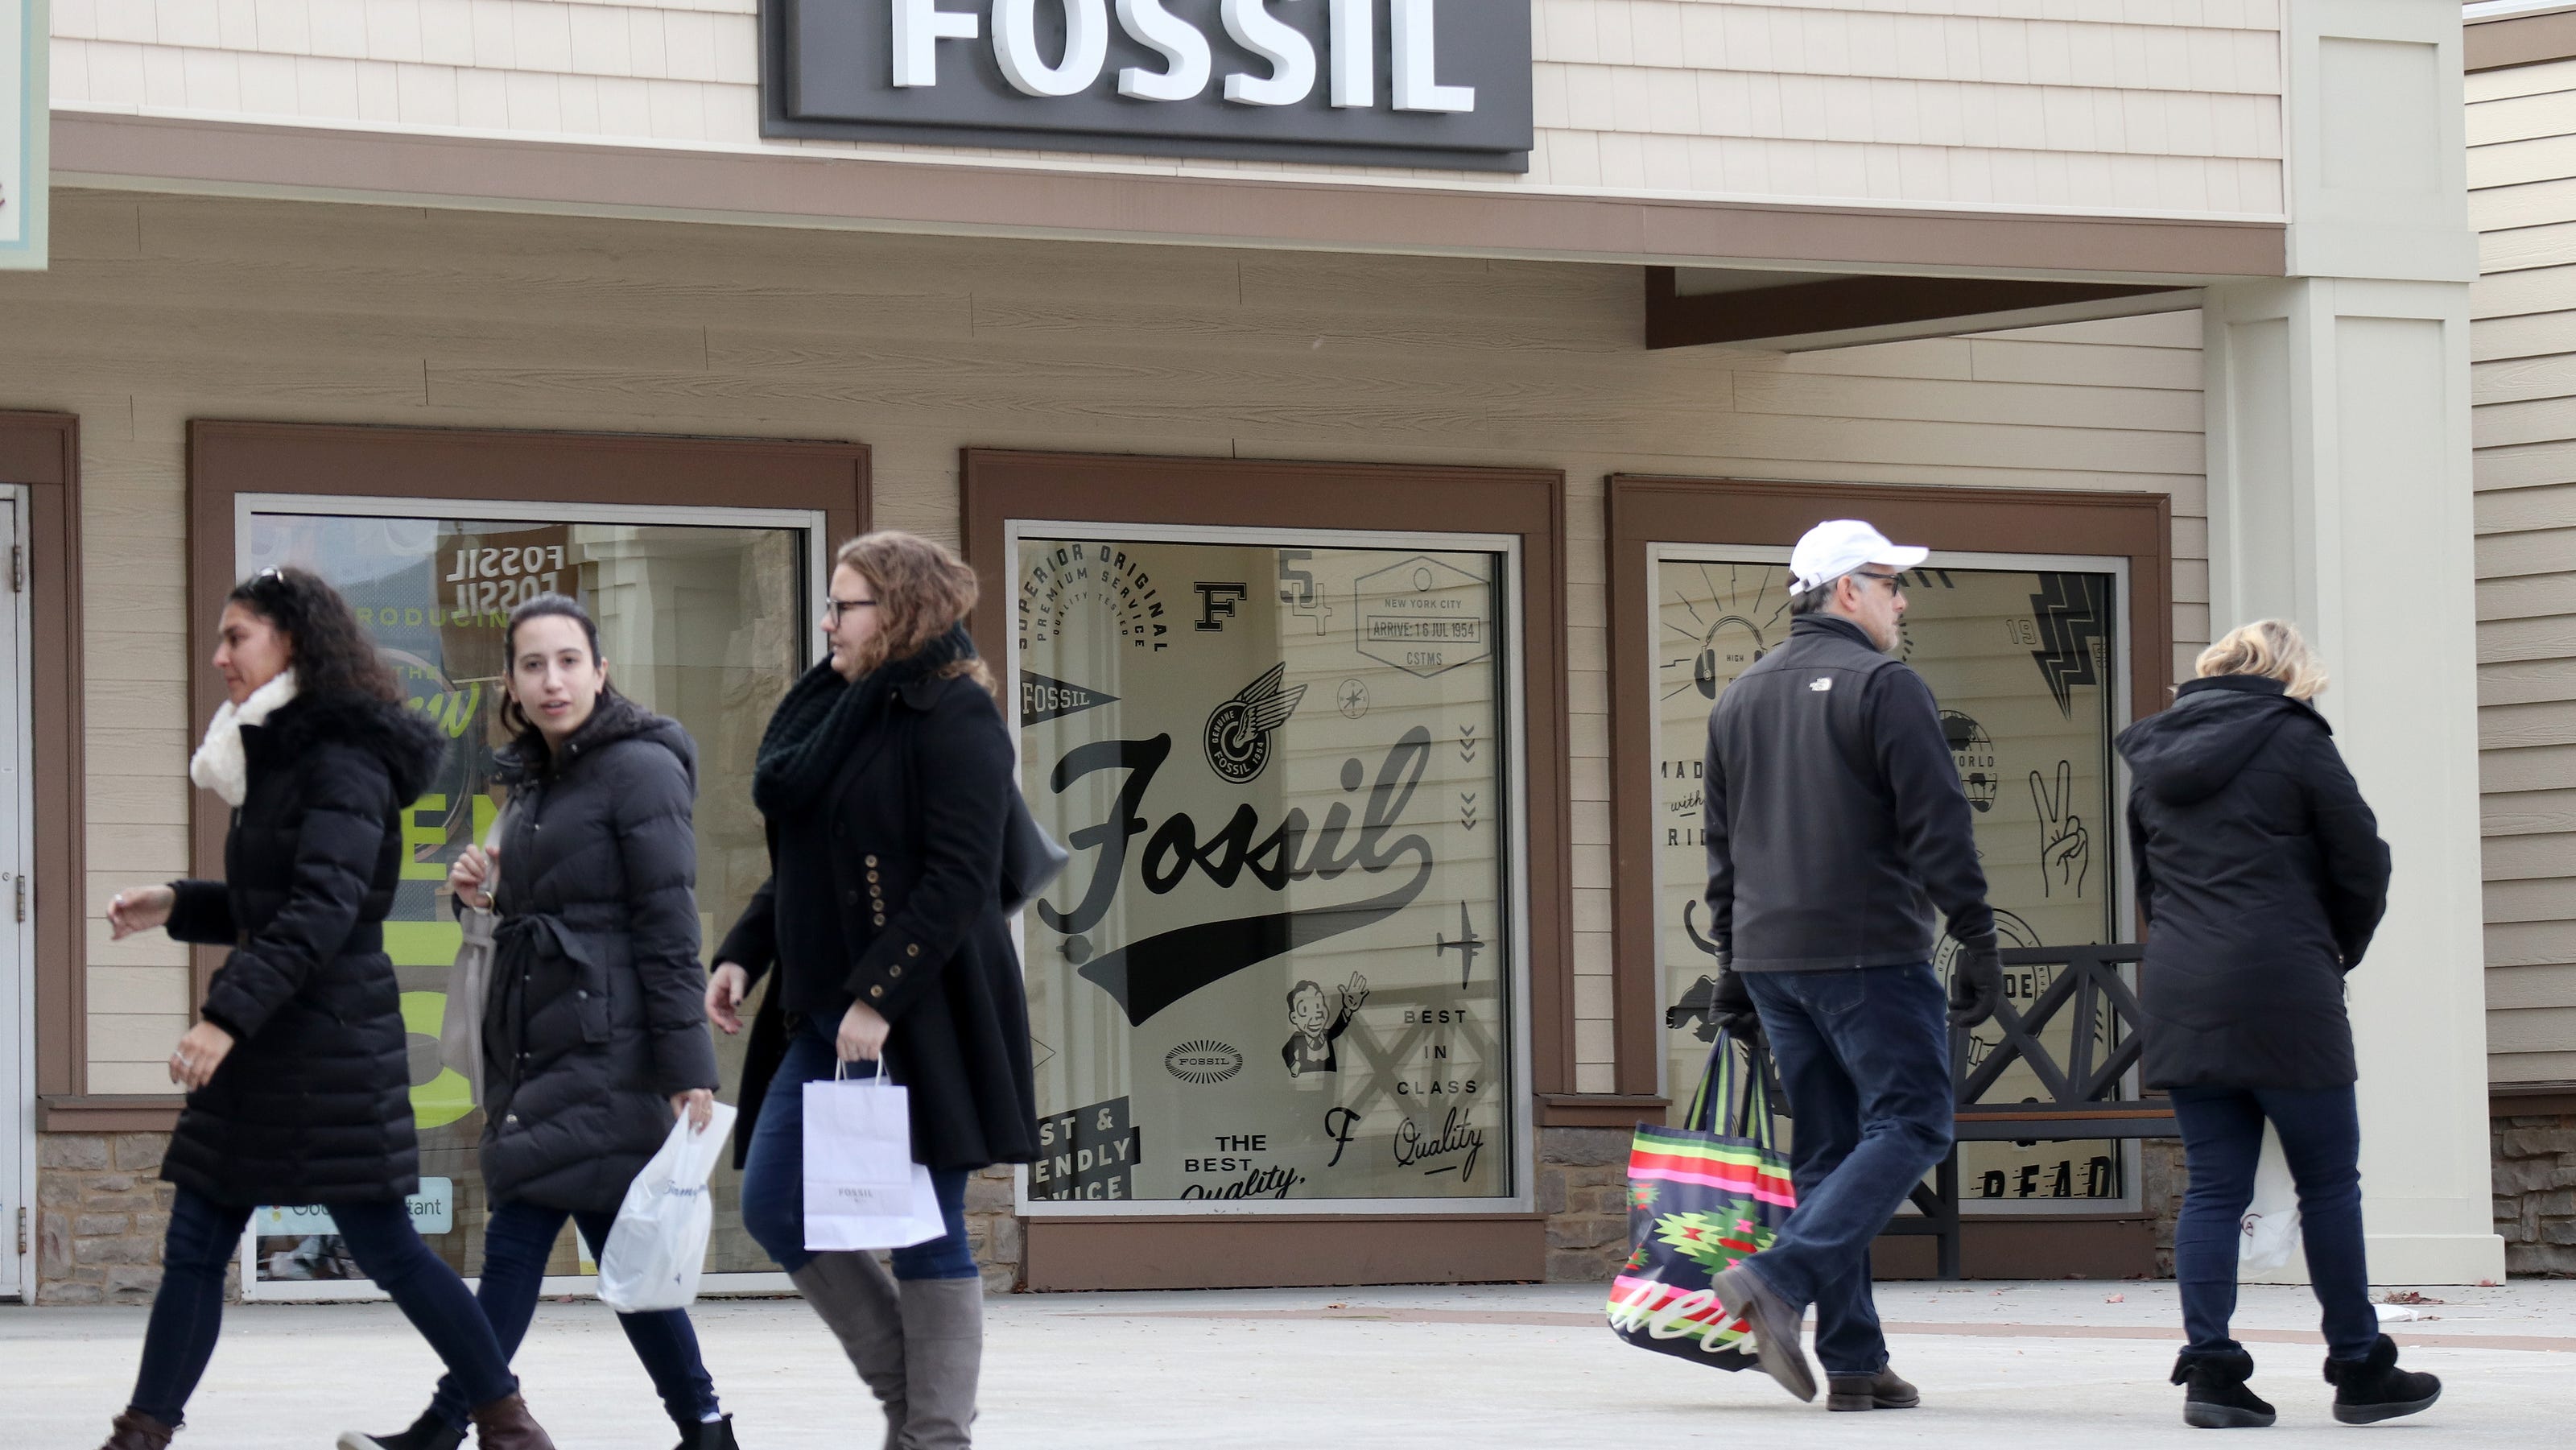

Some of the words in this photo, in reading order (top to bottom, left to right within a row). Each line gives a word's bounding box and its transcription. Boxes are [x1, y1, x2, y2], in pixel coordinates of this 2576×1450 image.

[892, 0, 1475, 114] FOSSIL
[1018, 543, 1084, 650] SUPERIOR
[1100, 545, 1168, 652] ORIGINAL
[1037, 567, 1088, 642] PREMIUM
[1101, 570, 1145, 647] SERVICE
[1193, 581, 1247, 632] F
[1385, 598, 1406, 608] NEW
[1410, 599, 1437, 609] YORK
[1440, 600, 1462, 609] CITY
[1053, 592, 1088, 635] QUALITY
[1098, 593, 1129, 635] TESTED
[1373, 621, 1413, 638] ARRIVE:
[1431, 622, 1448, 638] JUL
[1451, 622, 1475, 638] 1954
[1406, 651, 1443, 666] CSTMS
[1726, 655, 1744, 663] HIGH
[1022, 682, 1090, 715] FOSSIL
[1212, 710, 1235, 744] GENUINE
[1213, 750, 1250, 775] FOSSIL
[1252, 742, 1264, 764] 1954
[1953, 755, 1994, 767] ORLD
[1670, 789, 1706, 812] with
[1037, 725, 1433, 935] Fossil
[1404, 1010, 1466, 1024] BEST
[1179, 1057, 1230, 1065] FOSSIL
[1425, 1045, 1447, 1060] IN
[1397, 1080, 1476, 1095] CLASS
[1039, 1116, 1075, 1146] ST
[1096, 1107, 1114, 1131] &
[1215, 1134, 1267, 1152] THE
[1393, 1106, 1484, 1183] Quality
[1035, 1137, 1130, 1184] ENDLY
[1185, 1158, 1252, 1173] BEST
[838, 1188, 873, 1198] FOSSIL
